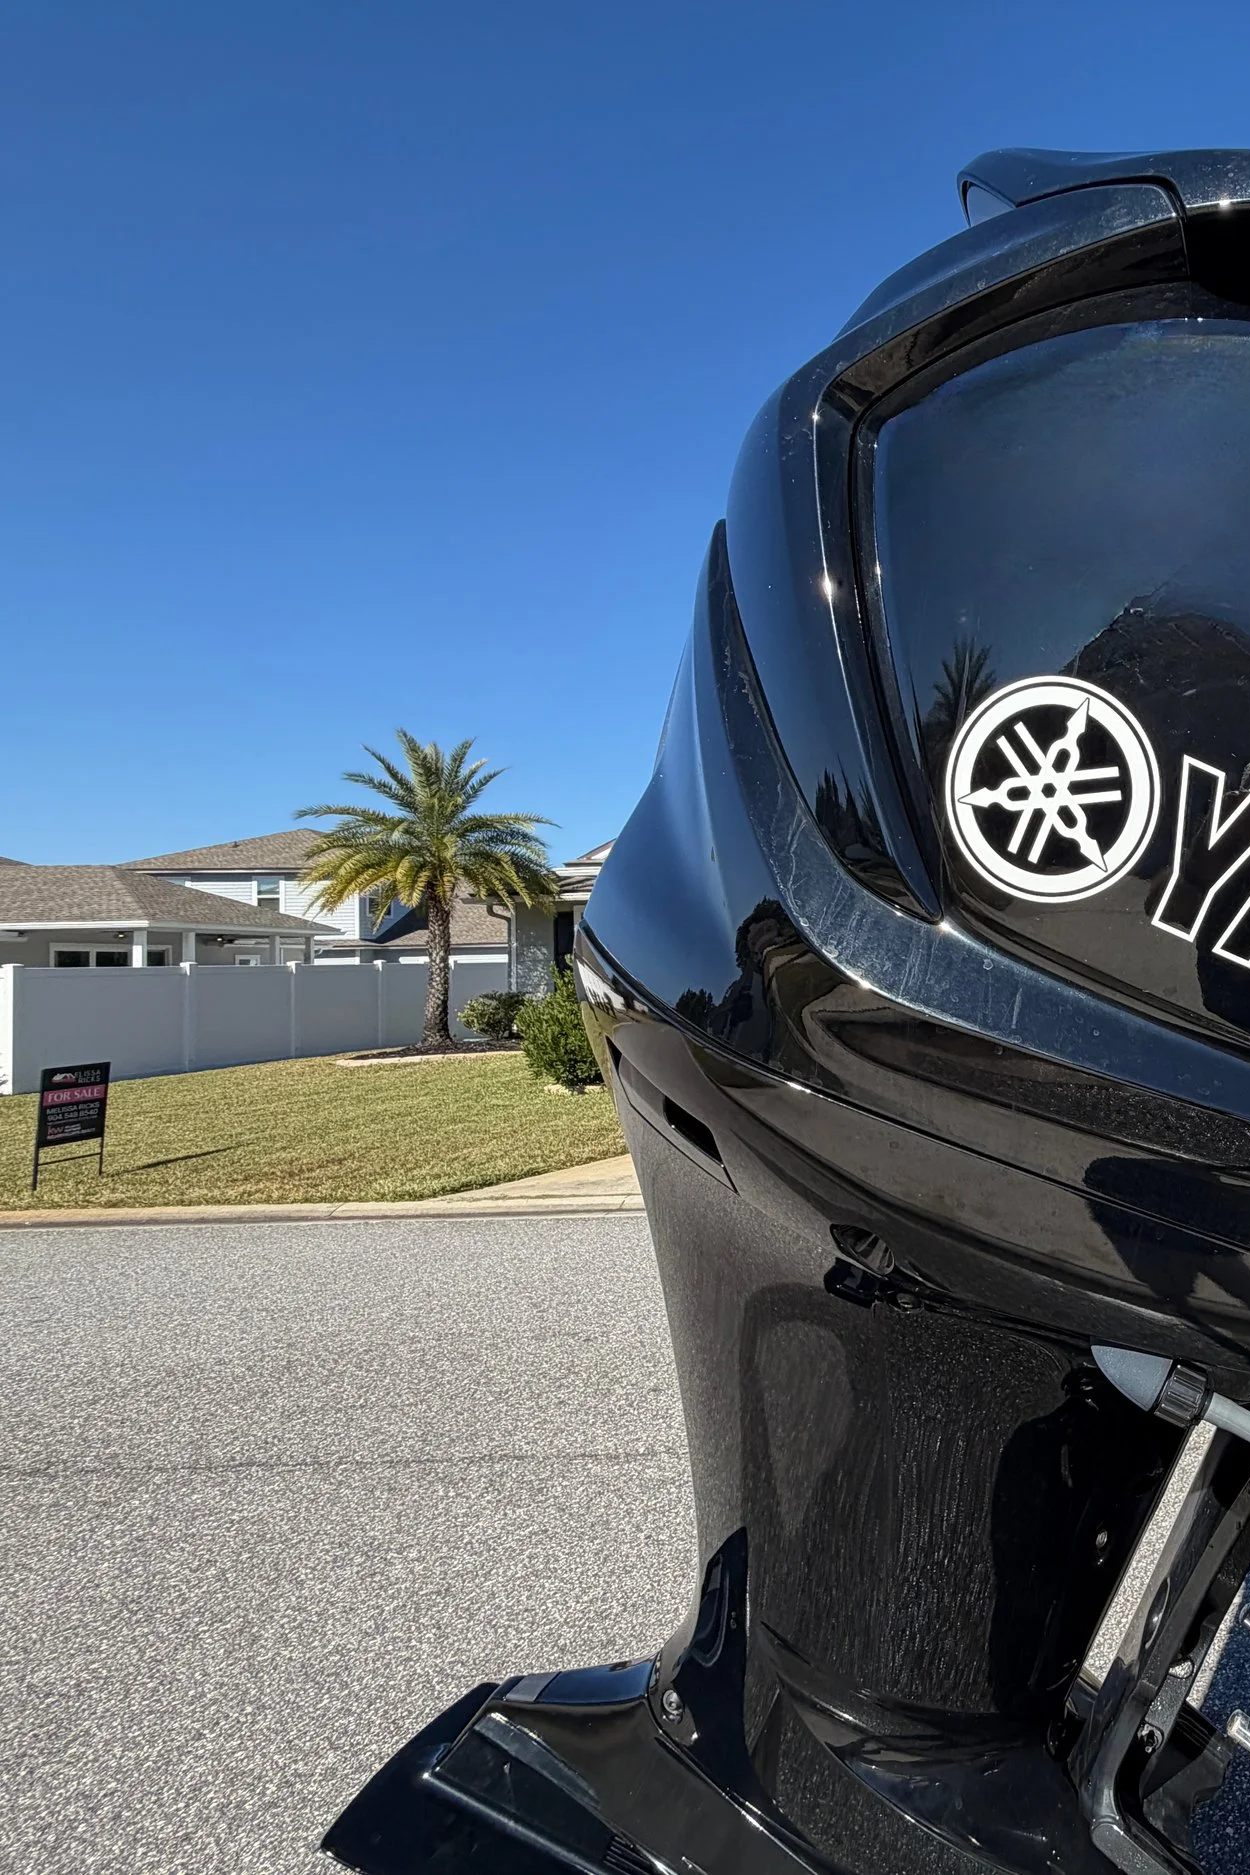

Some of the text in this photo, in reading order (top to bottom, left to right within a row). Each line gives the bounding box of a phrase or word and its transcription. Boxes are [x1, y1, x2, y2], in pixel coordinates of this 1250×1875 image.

[48, 1088, 100, 1102] FOR SALE
[46, 1105, 78, 1115] MELISSA
